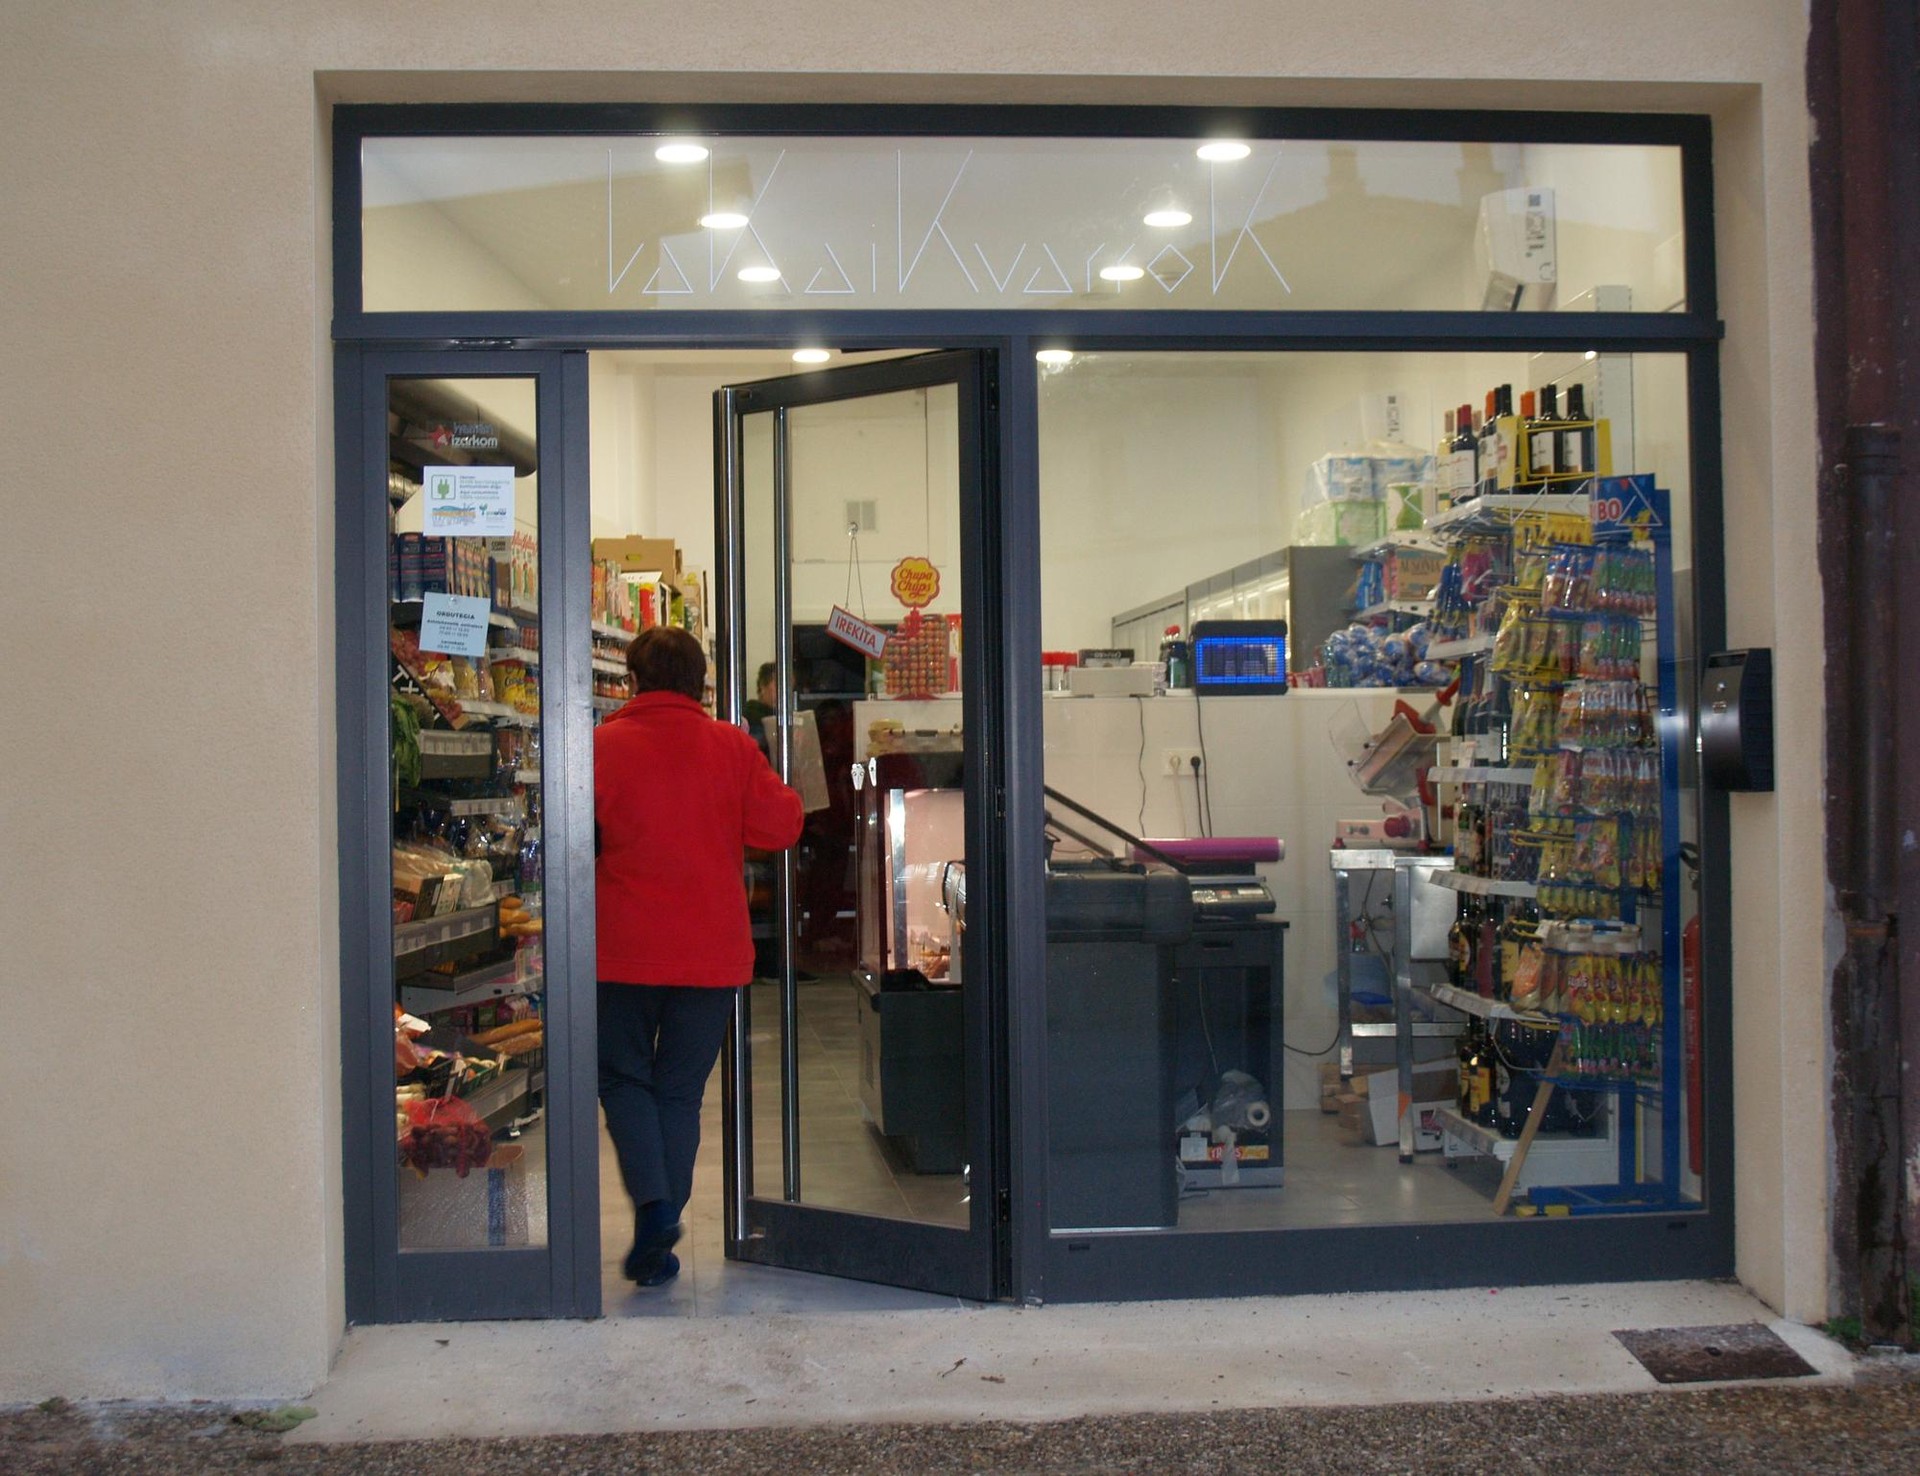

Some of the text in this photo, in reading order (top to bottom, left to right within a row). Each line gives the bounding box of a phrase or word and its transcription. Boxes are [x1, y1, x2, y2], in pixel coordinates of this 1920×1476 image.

[451, 433, 498, 447] izarkom
[899, 568, 933, 582] Chupa
[897, 580, 932, 598] Chups
[835, 614, 877, 650] IREKITA
